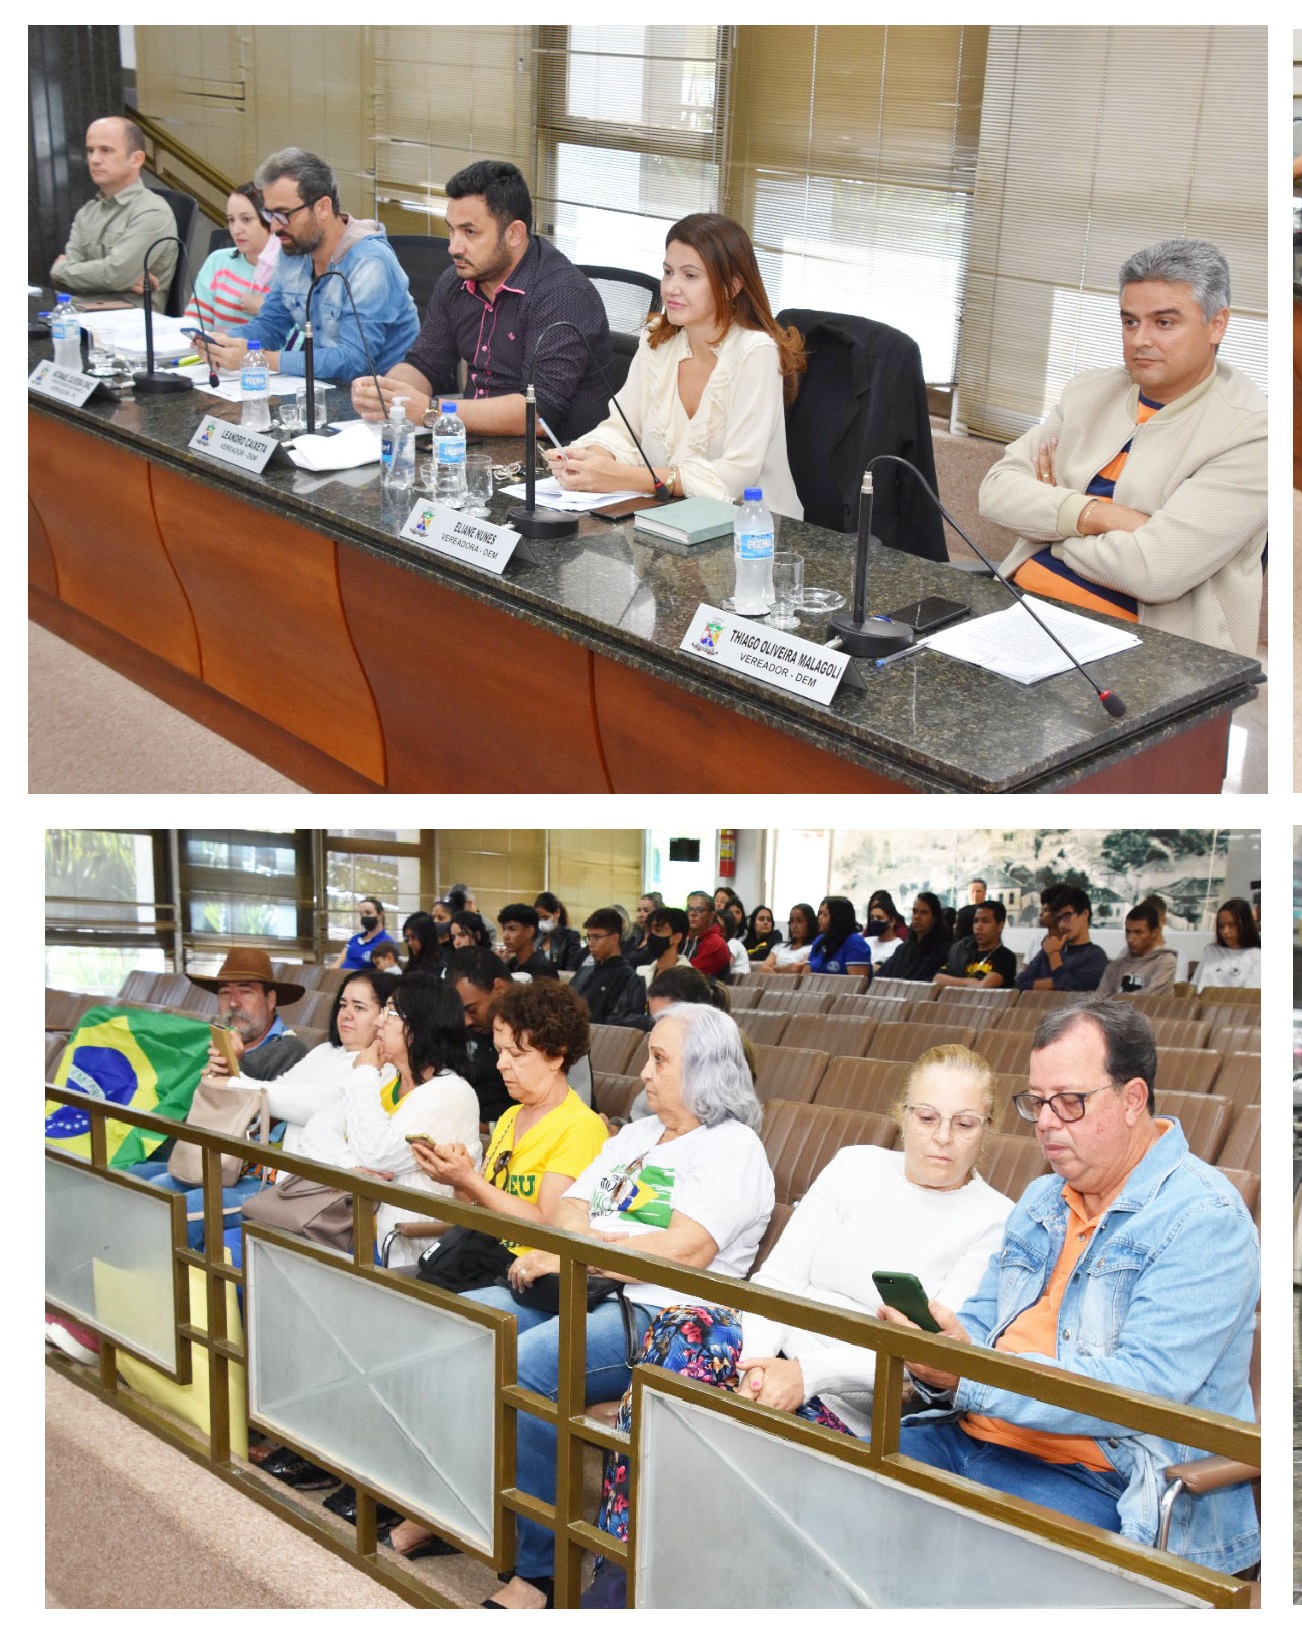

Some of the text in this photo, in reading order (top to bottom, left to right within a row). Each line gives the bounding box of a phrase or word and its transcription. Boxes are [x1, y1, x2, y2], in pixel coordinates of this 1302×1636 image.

[220, 443, 245, 457] VEREADOR
[247, 452, 259, 461] DEM
[221, 429, 268, 453] LEANDRO CAIXETA
[453, 521, 498, 545] ELIANE NUNES
[441, 533, 479, 552] VEREADORA
[482, 549, 499, 559] DEM
[730, 629, 760, 651] THIAGO
[760, 641, 799, 664] OLIVEIRA
[798, 654, 843, 680] MALAGOLI
[740, 652, 790, 677] VEREADOR
[795, 673, 817, 688] DEM
[504, 1174, 536, 1196] EU
